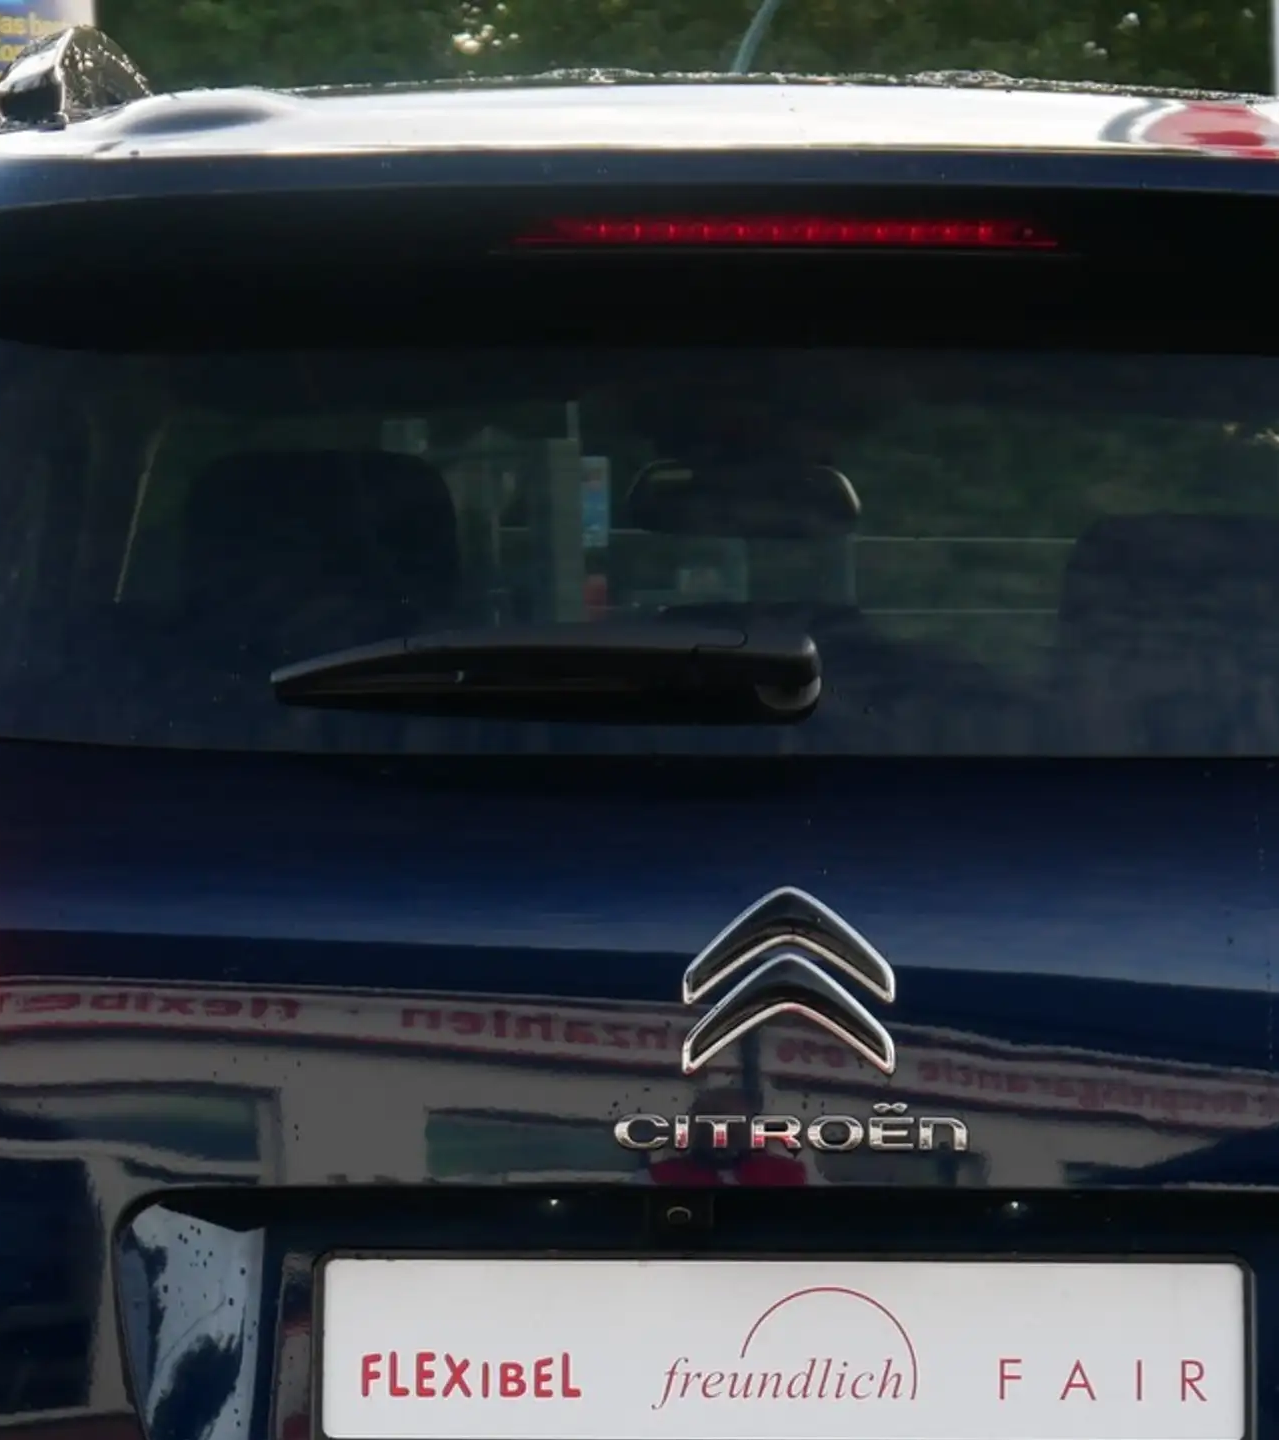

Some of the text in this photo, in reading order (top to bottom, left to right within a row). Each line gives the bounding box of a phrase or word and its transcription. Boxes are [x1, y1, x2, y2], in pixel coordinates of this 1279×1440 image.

[360, 1351, 1209, 1409] FLEXIBEL freundlich FAIR
